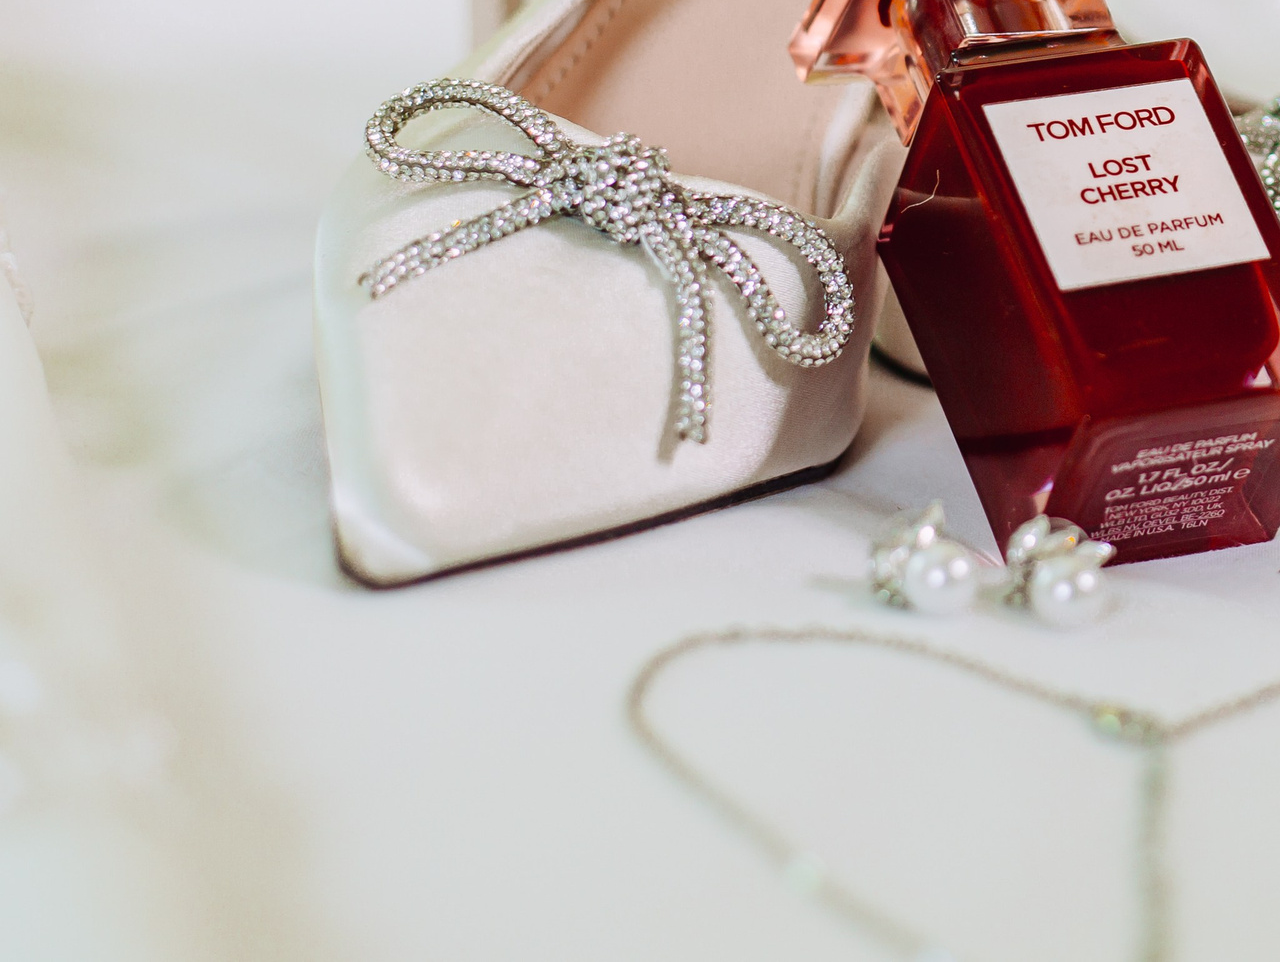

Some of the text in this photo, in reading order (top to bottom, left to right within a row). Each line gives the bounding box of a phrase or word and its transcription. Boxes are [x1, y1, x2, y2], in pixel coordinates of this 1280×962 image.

[1026, 106, 1176, 142] TOM FORD
[1088, 154, 1152, 179] LOST
[1080, 175, 1180, 205] CHERRY
[1074, 213, 1224, 246] EAU DE PARFUM
[1131, 239, 1185, 257] 50 ML
[1136, 432, 1258, 459] EAU DE PARFUM
[1225, 439, 1275, 454] SPRAY
[1207, 501, 1224, 510] UK
